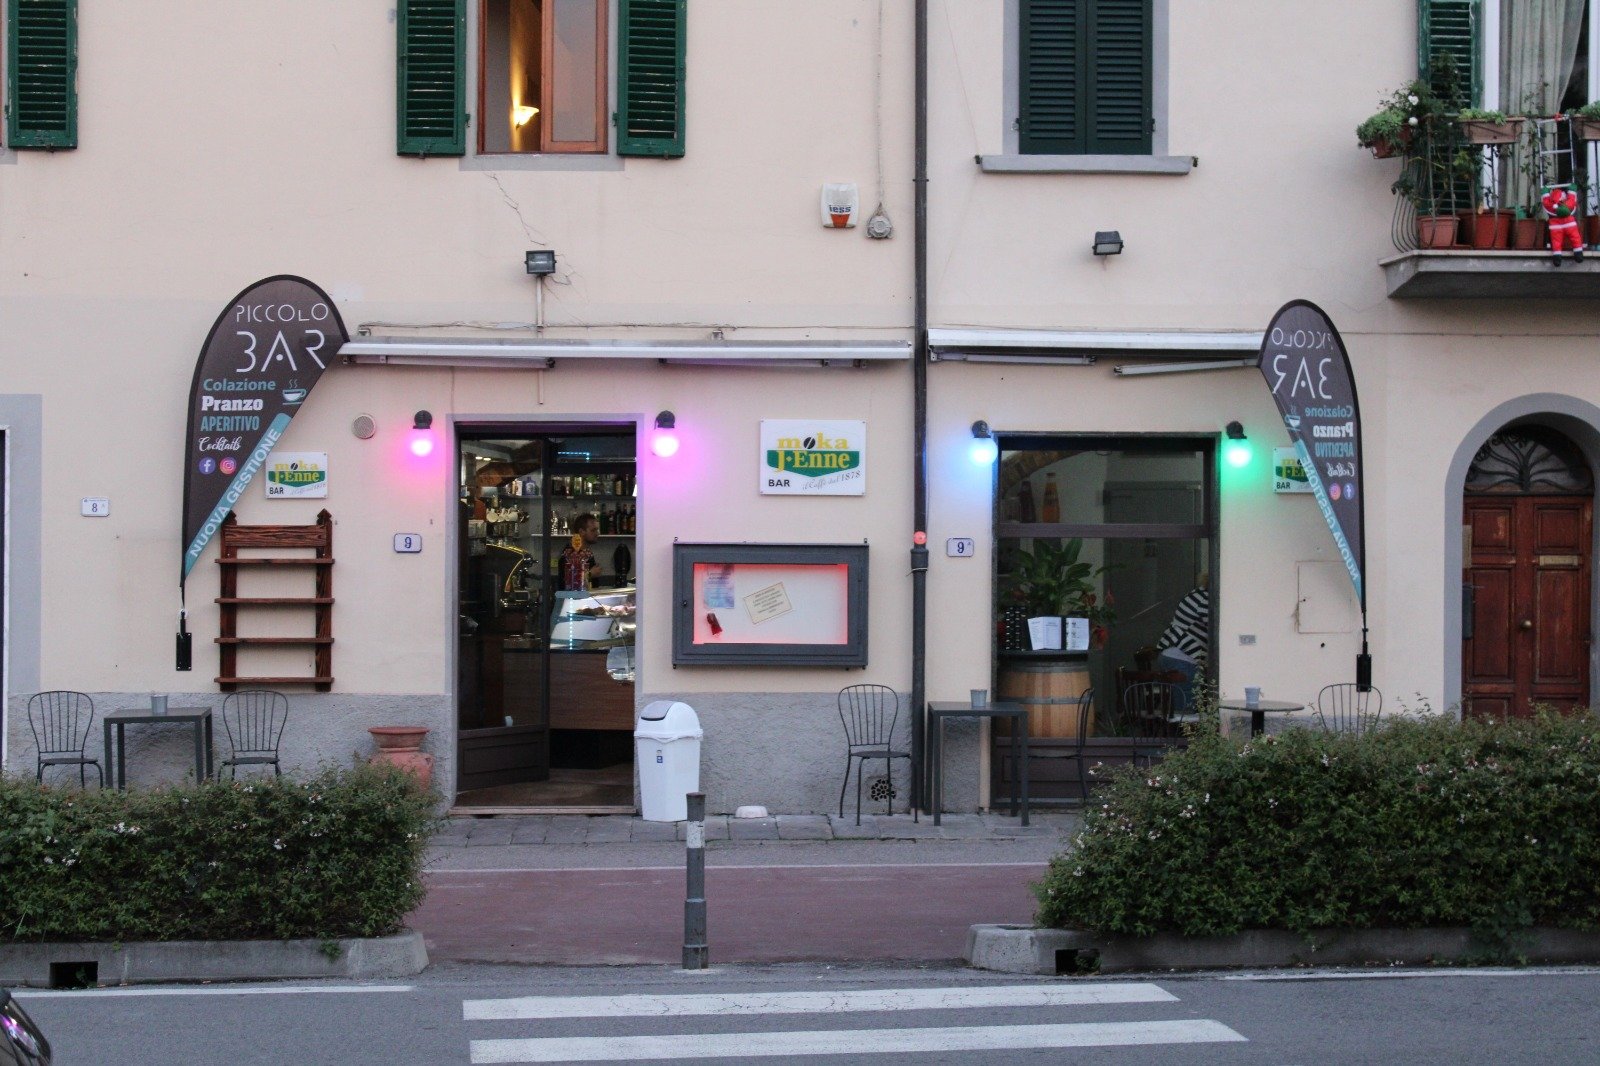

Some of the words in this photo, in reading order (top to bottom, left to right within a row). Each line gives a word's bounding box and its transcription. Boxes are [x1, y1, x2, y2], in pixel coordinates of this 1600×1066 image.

[236, 303, 329, 323] PICCOLO
[236, 329, 326, 373] BAR
[203, 378, 276, 392] Colazione
[201, 395, 264, 411] Pranzo
[200, 415, 260, 431] APERITIVO
[198, 436, 243, 452] Cocktails
[841, 470, 861, 481] 1878
[768, 479, 790, 487] BAR
[1276, 481, 1291, 490] BAR
[189, 506, 231, 557] NUOVA
[226, 427, 281, 504] GESTIONE
[269, 487, 284, 495] BAR
[91, 502, 98, 513] 8
[404, 536, 412, 549] 9
